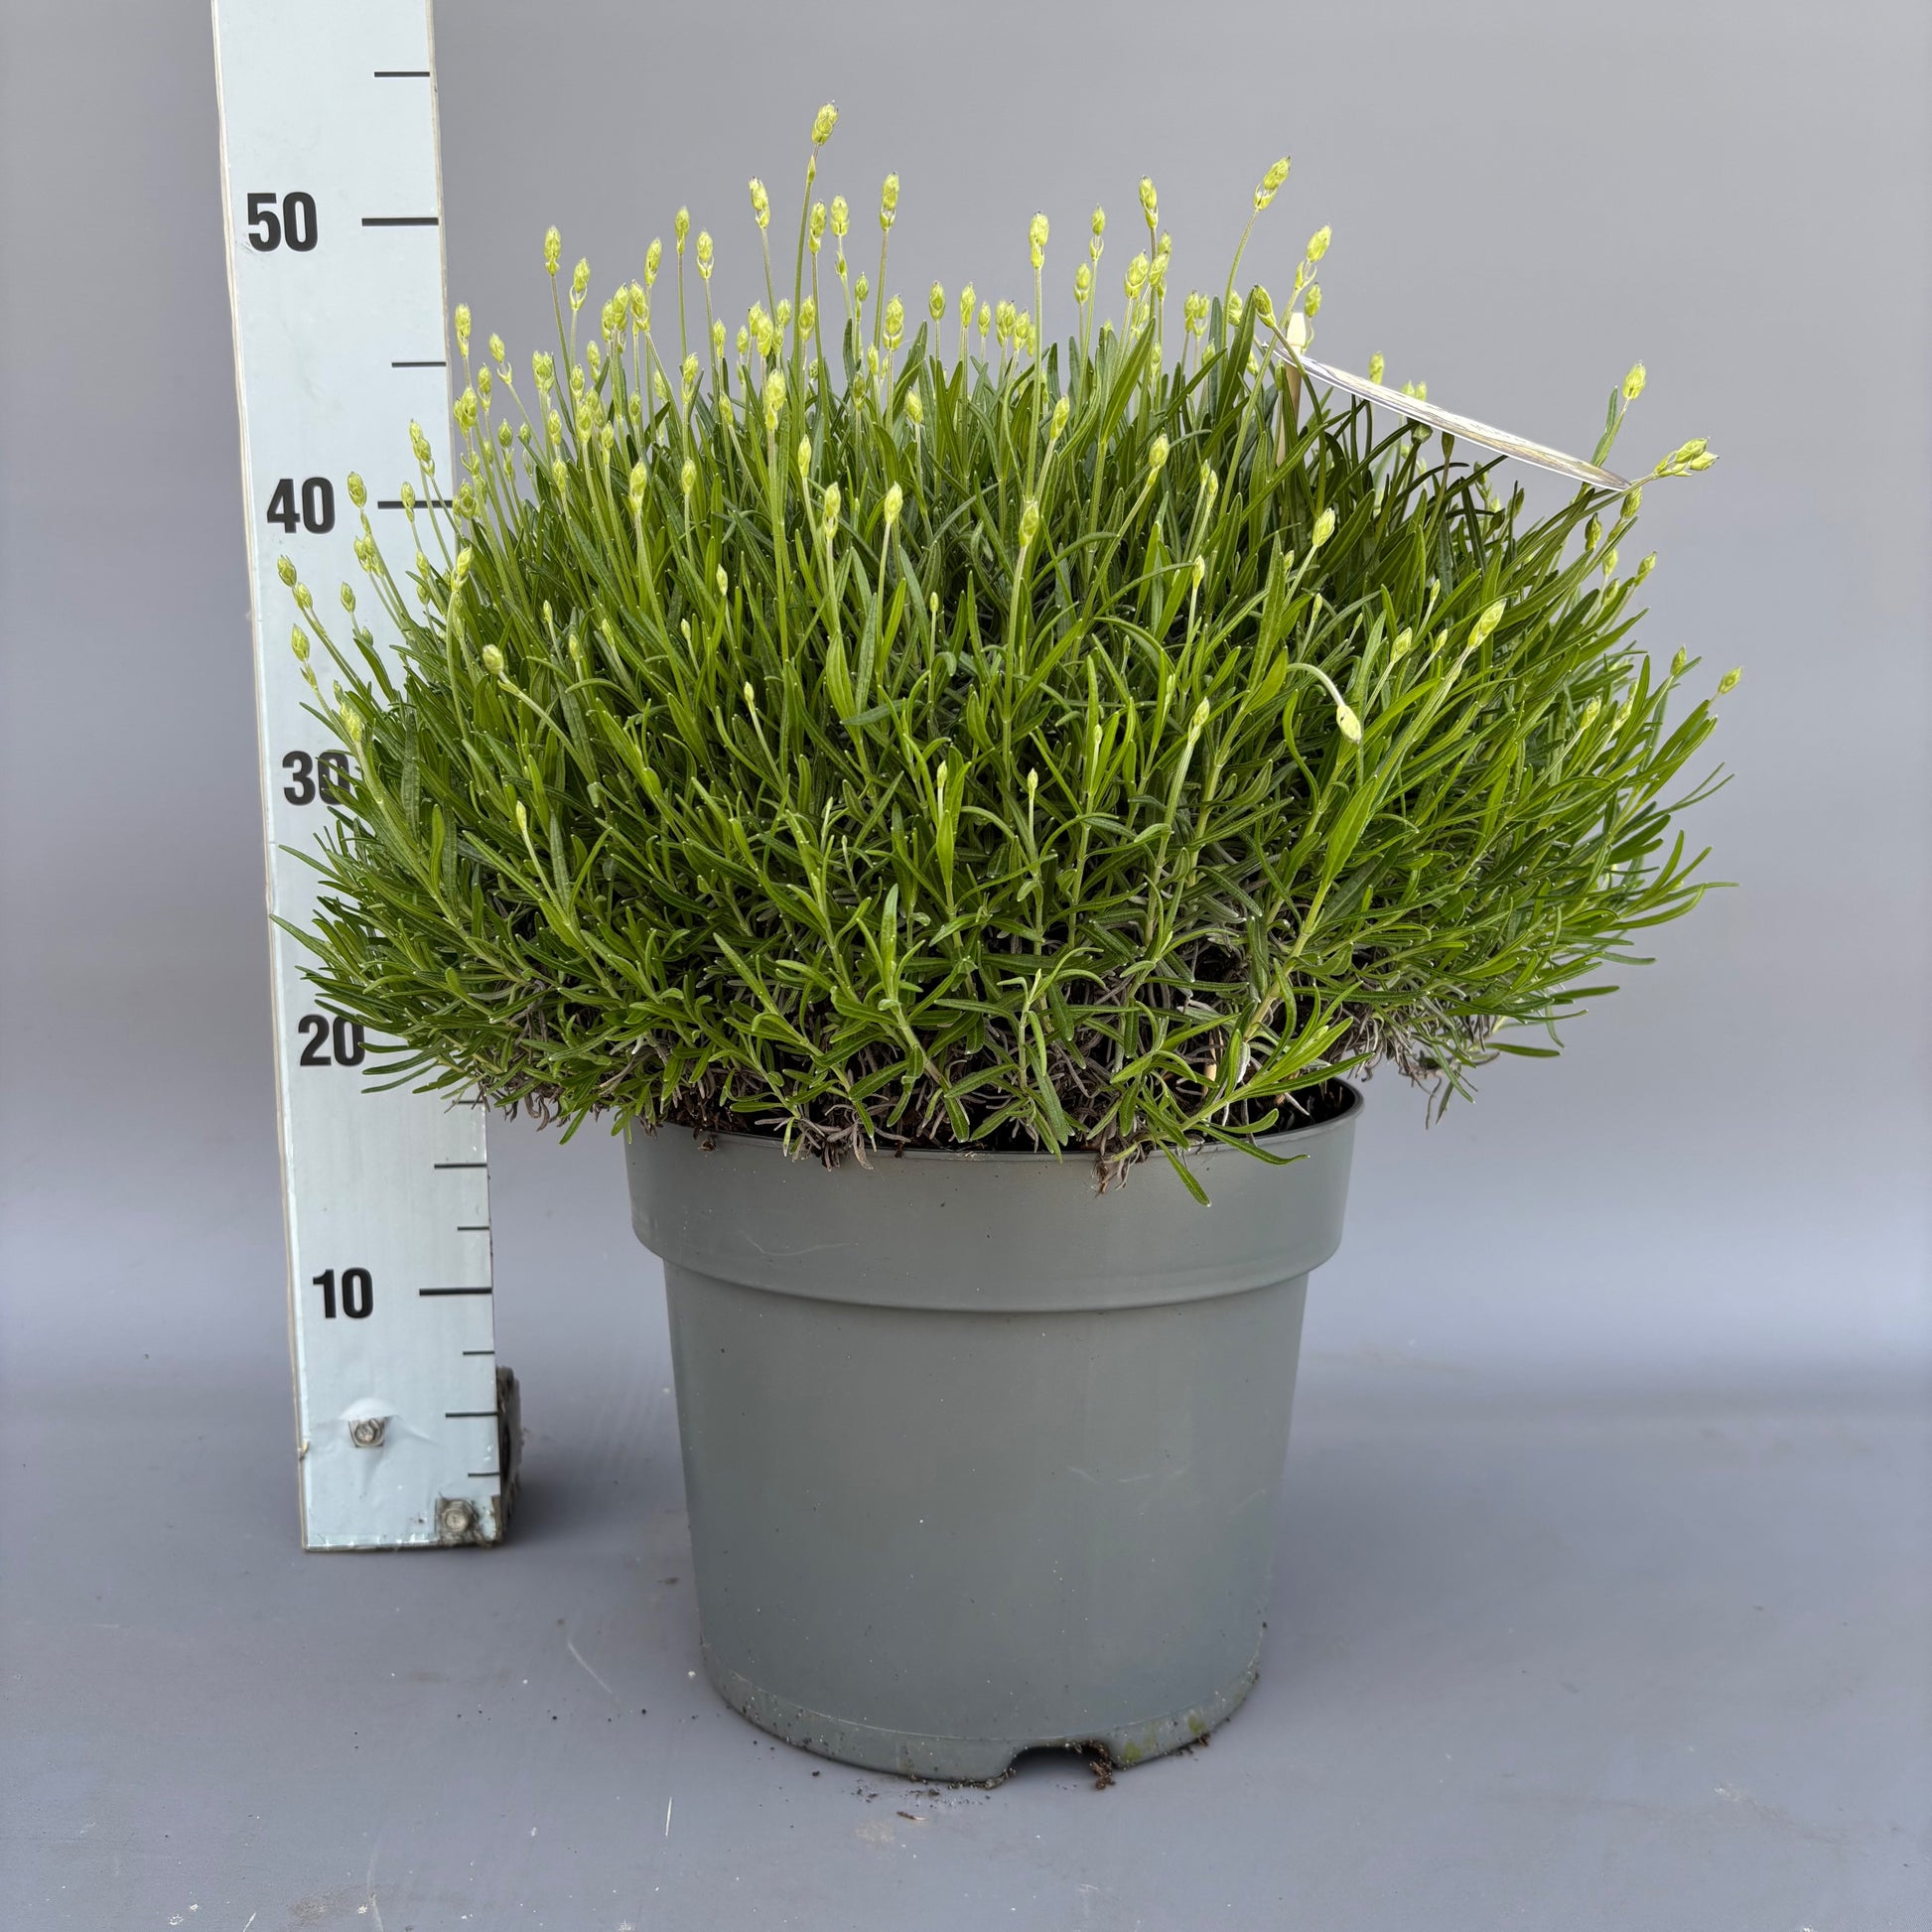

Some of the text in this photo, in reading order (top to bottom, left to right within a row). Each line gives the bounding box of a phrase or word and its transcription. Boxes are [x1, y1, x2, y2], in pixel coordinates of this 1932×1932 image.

[247, 192, 319, 252] 50
[266, 477, 336, 534] 40
[281, 750, 351, 806] 30
[298, 1014, 366, 1067] 20
[312, 1267, 374, 1319] 10
